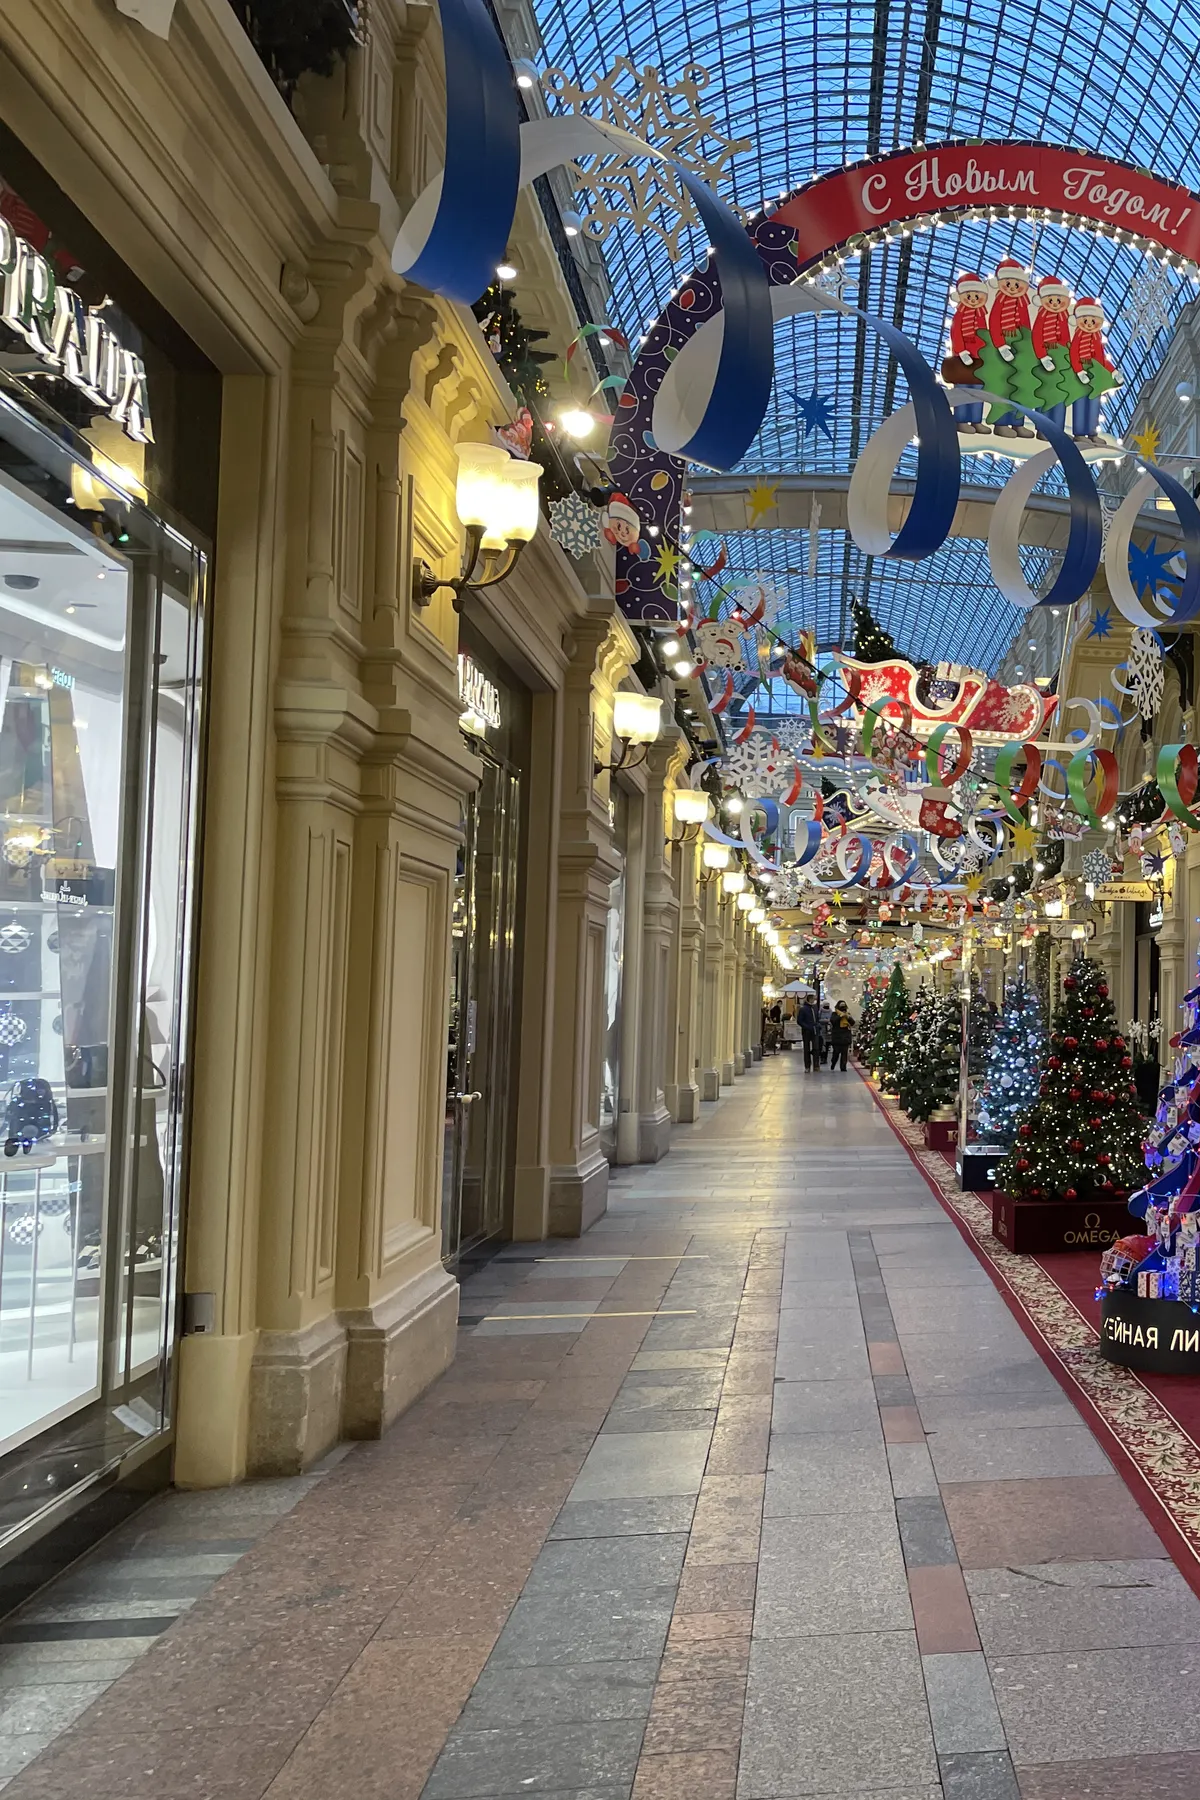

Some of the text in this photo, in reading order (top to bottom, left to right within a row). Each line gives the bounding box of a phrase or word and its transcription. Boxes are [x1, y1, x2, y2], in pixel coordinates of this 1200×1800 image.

[861, 156, 1192, 236] С Новым Годом!
[1063, 1230, 1121, 1244] OMEGA
